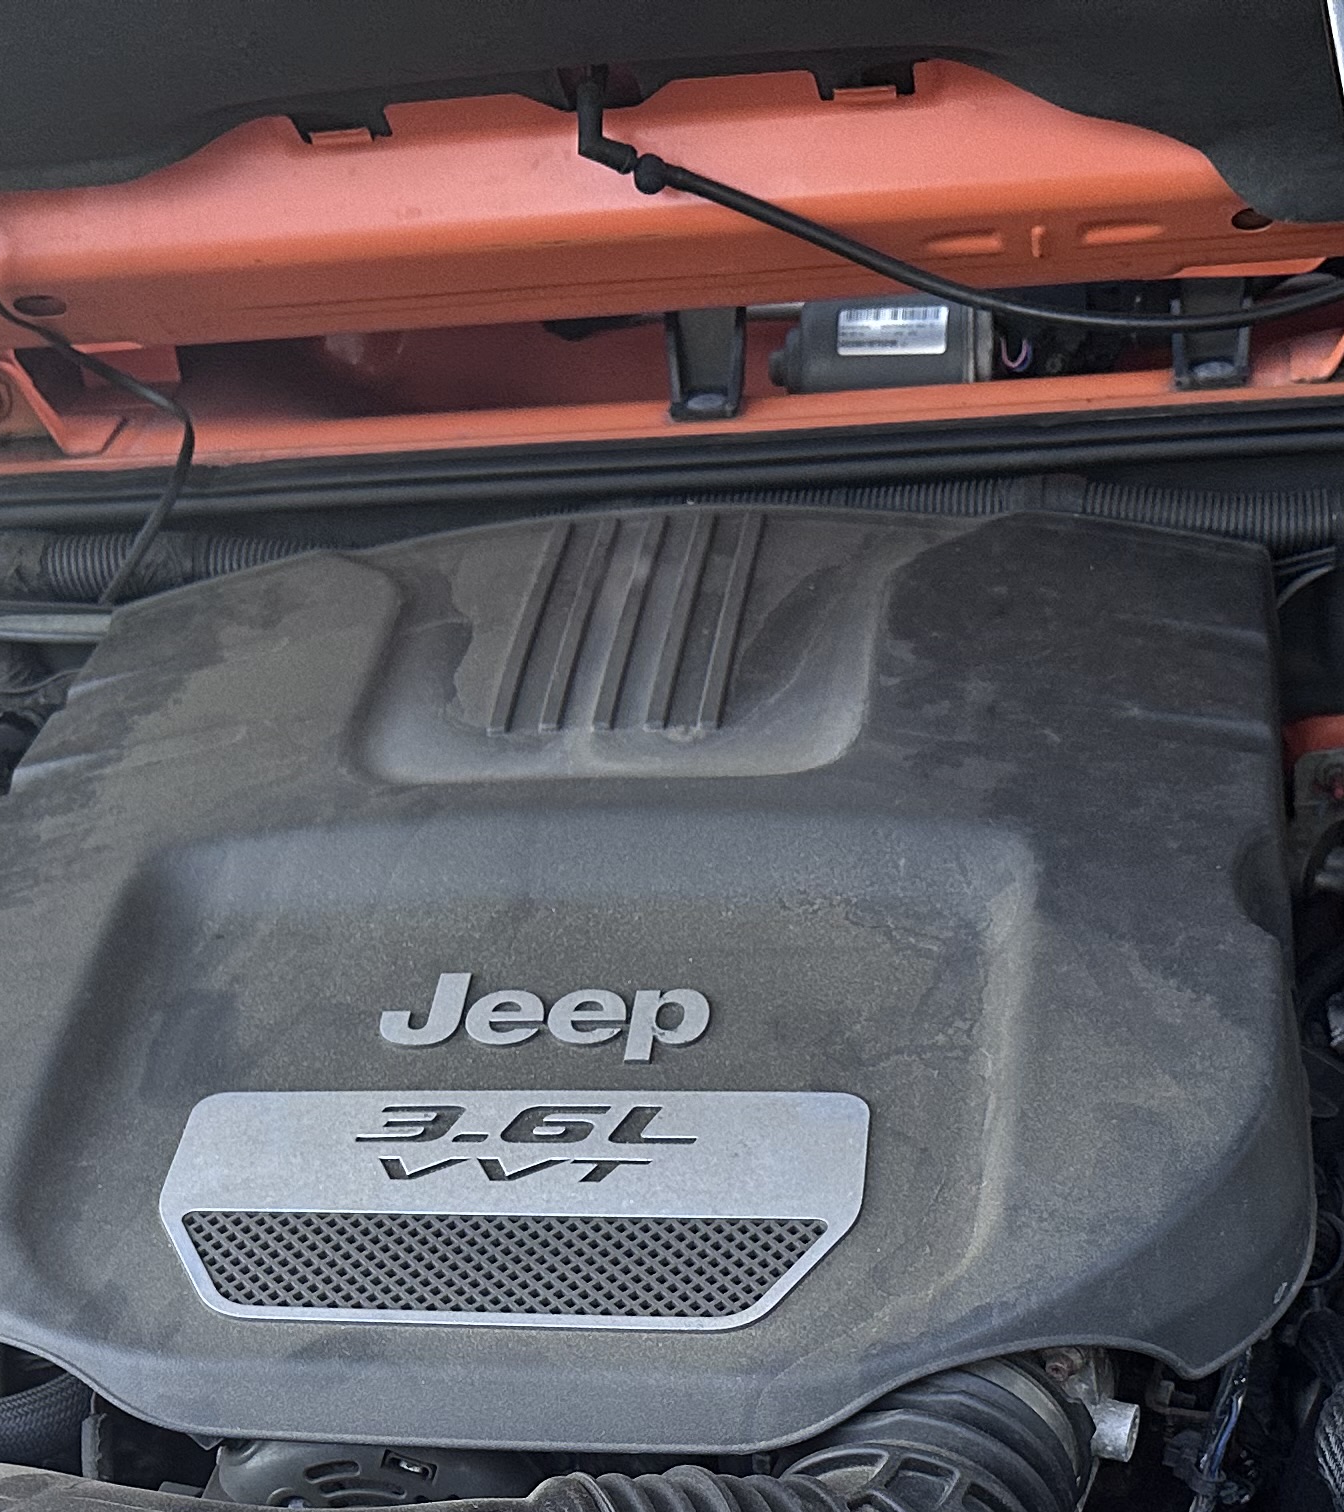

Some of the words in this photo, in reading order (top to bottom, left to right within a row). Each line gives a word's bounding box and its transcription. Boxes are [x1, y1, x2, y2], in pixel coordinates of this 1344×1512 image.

[379, 972, 711, 1064] Jeep
[355, 1105, 698, 1144] 3.6L
[377, 1155, 653, 1183] VVT
